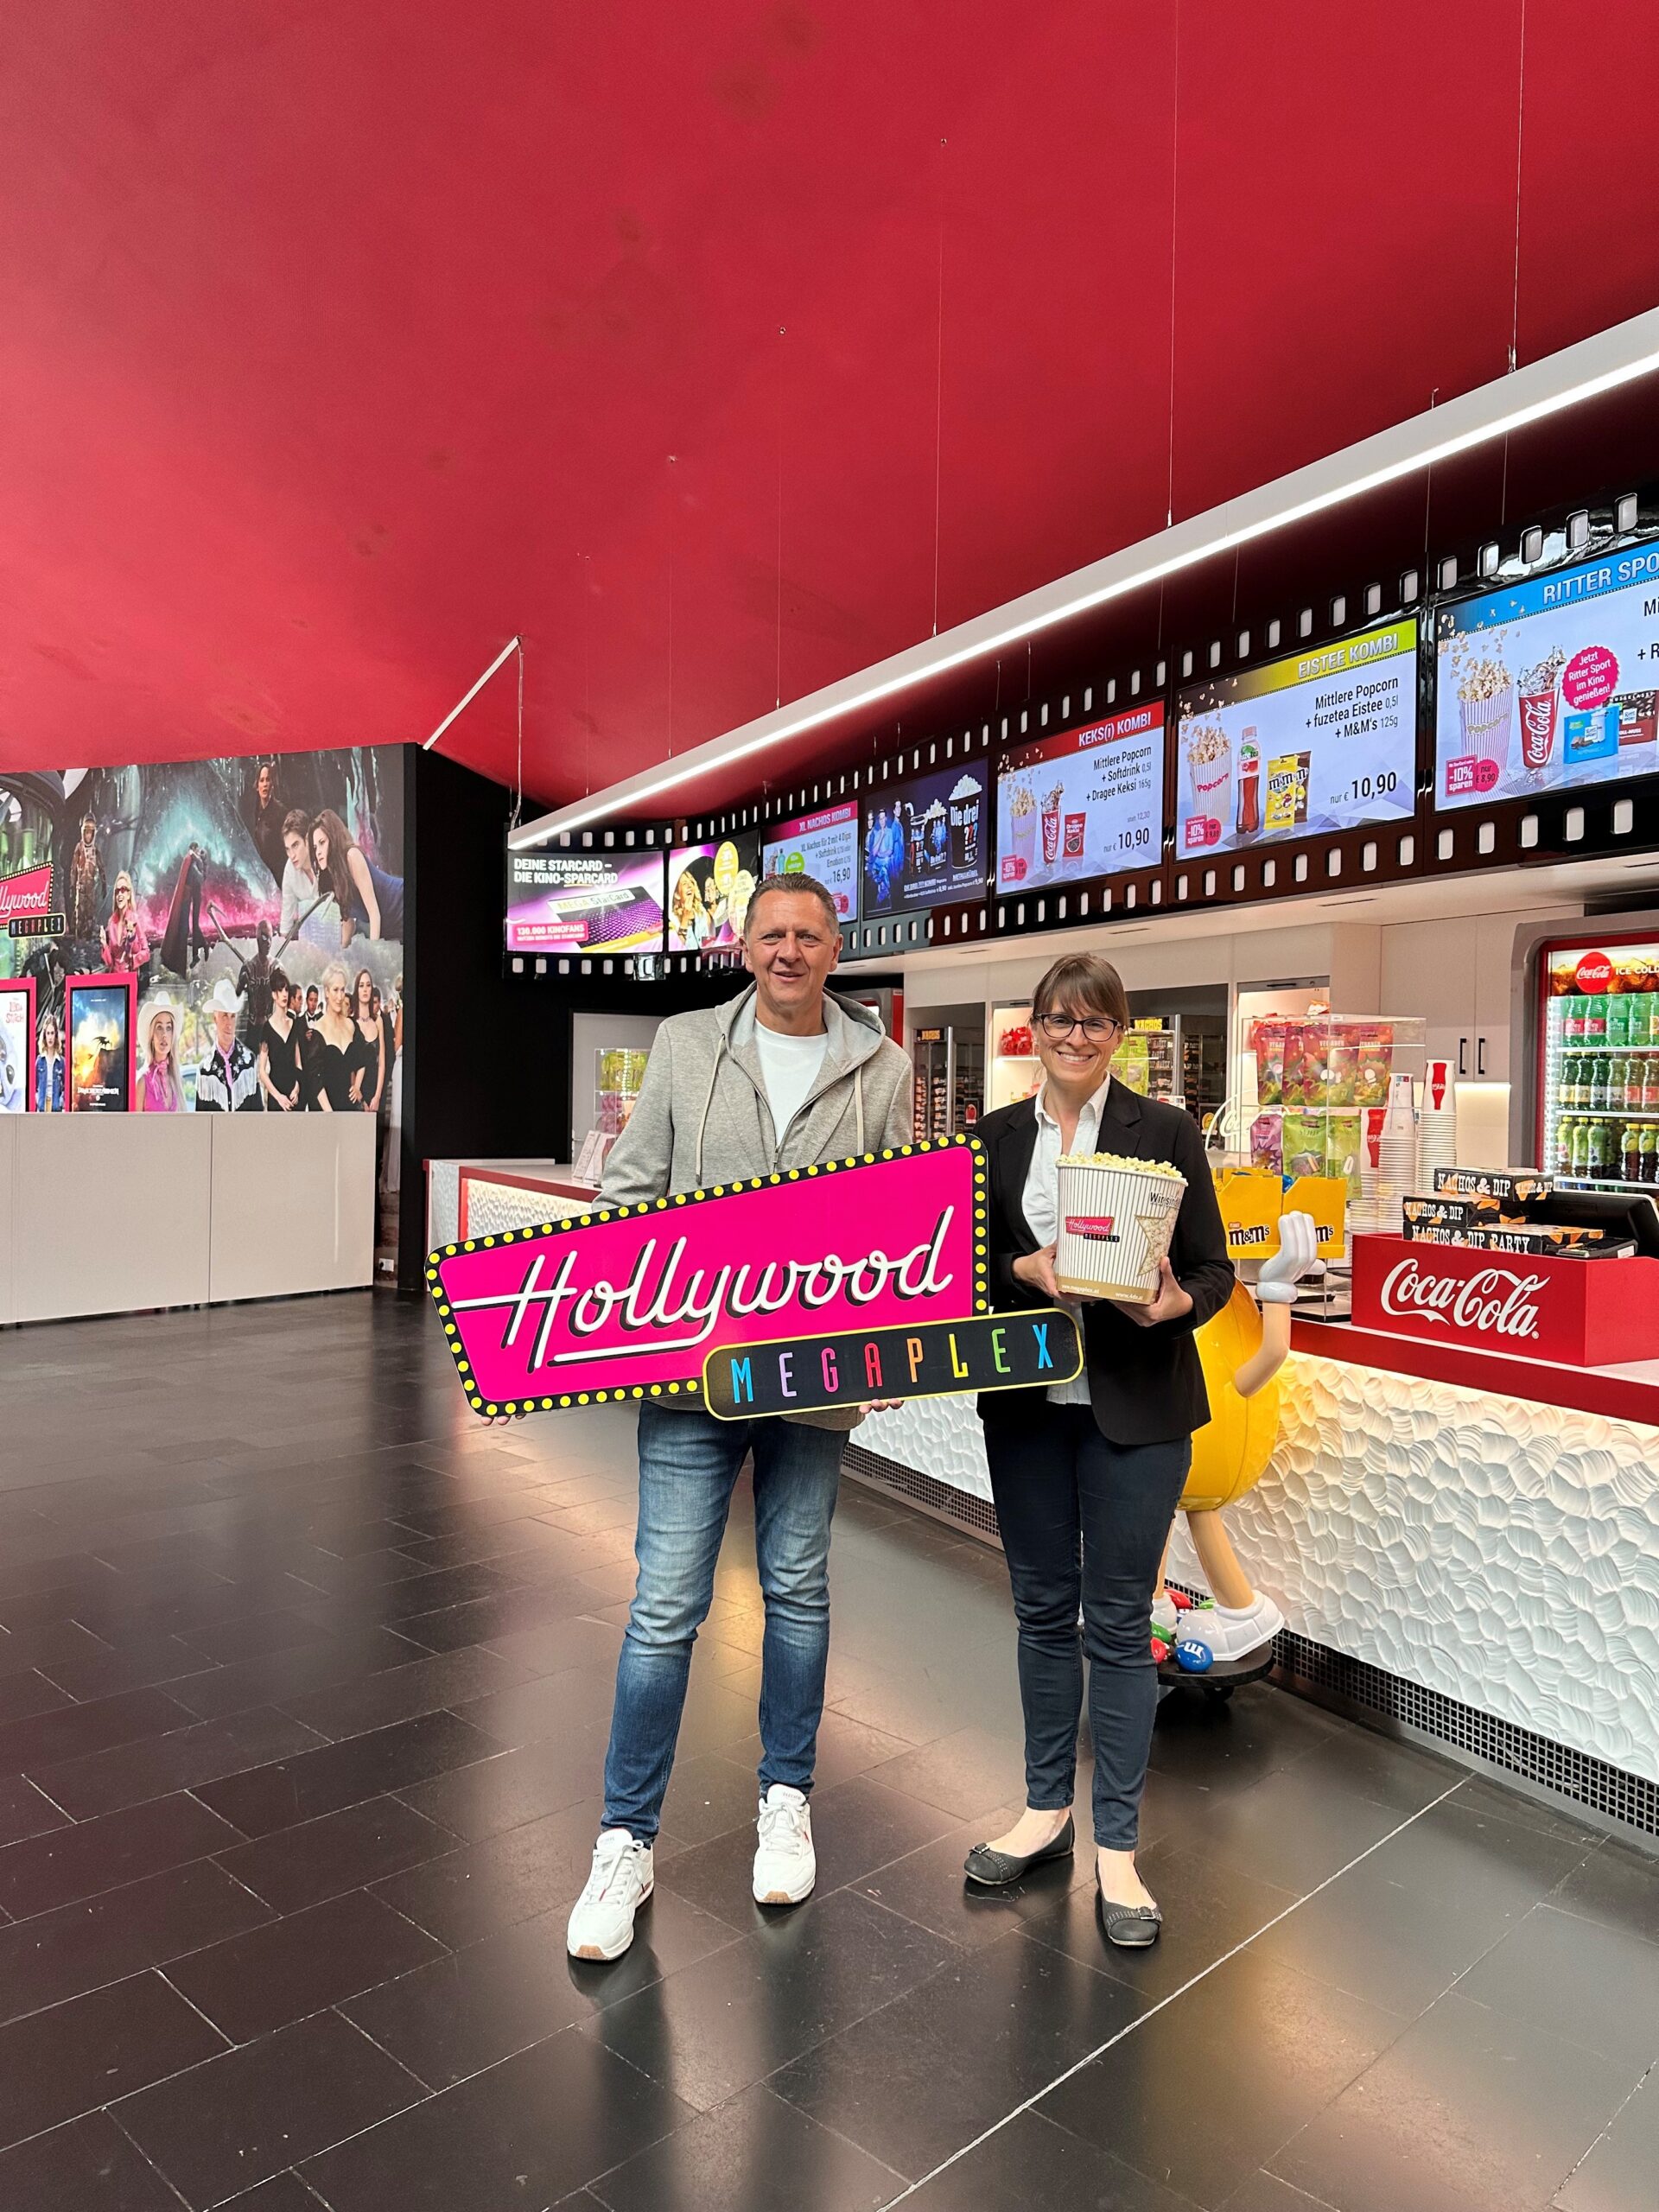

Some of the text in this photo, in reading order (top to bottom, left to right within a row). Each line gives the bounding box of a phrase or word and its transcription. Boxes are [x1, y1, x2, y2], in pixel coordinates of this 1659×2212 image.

[1542, 567, 1611, 605] RITTER
[1298, 632, 1398, 679] EISTEE KOMBI
[1579, 651, 1599, 666] Jetzt
[1568, 658, 1611, 682] Ritter Sport
[1315, 677, 1398, 710] Mittlere Popcorn
[1576, 674, 1605, 690] im Kino
[1573, 683, 1611, 706] genießen!
[1306, 719, 1311, 728] +
[1313, 709, 1350, 729] fuzetea
[1352, 701, 1383, 720] Eistee
[1335, 728, 1341, 738] +
[1381, 715, 1398, 729] 125g
[1466, 711, 1509, 735] Popcorn
[1078, 711, 1152, 747] KEKS(i) KOMBI
[1525, 699, 1552, 764] Coca-Cola
[1093, 746, 1152, 771] Mittlere Popcorn
[1108, 763, 1141, 782] Softdrink
[1197, 772, 1229, 793] Popcorn
[1449, 766, 1473, 783] -10%
[1086, 779, 1151, 802] + Dragee Keksi 165g
[1330, 772, 1397, 804] nur € 10,90
[1449, 780, 1472, 792] sparen
[807, 813, 831, 830] NACHOS
[831, 807, 851, 822] KOMBI
[950, 799, 980, 827] Die drei
[963, 823, 978, 845] ???
[1044, 815, 1058, 860] Coca-Cola
[1118, 827, 1149, 850] 10,90
[513, 858, 547, 870] DEINE
[547, 860, 603, 872] STARCARD
[833, 867, 851, 884] 16,90
[513, 872, 618, 885] DIE KINO-SPARCARD
[590, 892, 630, 906] StarCard
[10, 917, 61, 935] MEGAPLEX
[547, 924, 584, 934] KINOFANS
[1576, 965, 1611, 980] Coca-Cola
[1615, 967, 1631, 976] ICE
[1134, 1018, 1163, 1031] NACHOS
[1437, 1173, 1511, 1198] NACHOS & DIP
[1536, 1182, 1544, 1192] &
[1544, 1182, 1553, 1193] DIP
[1150, 1192, 1164, 1204] Wir
[1405, 1202, 1464, 1221] NACHOS & DIP
[1065, 1218, 1110, 1233] Hollywood
[1411, 1225, 1530, 1254] NACHOS & DIP PARTY
[451, 1204, 954, 1373] Hollywood
[1381, 1257, 1552, 1340] Coca-Cola
[730, 1322, 1056, 1404] MEGAPLEX
